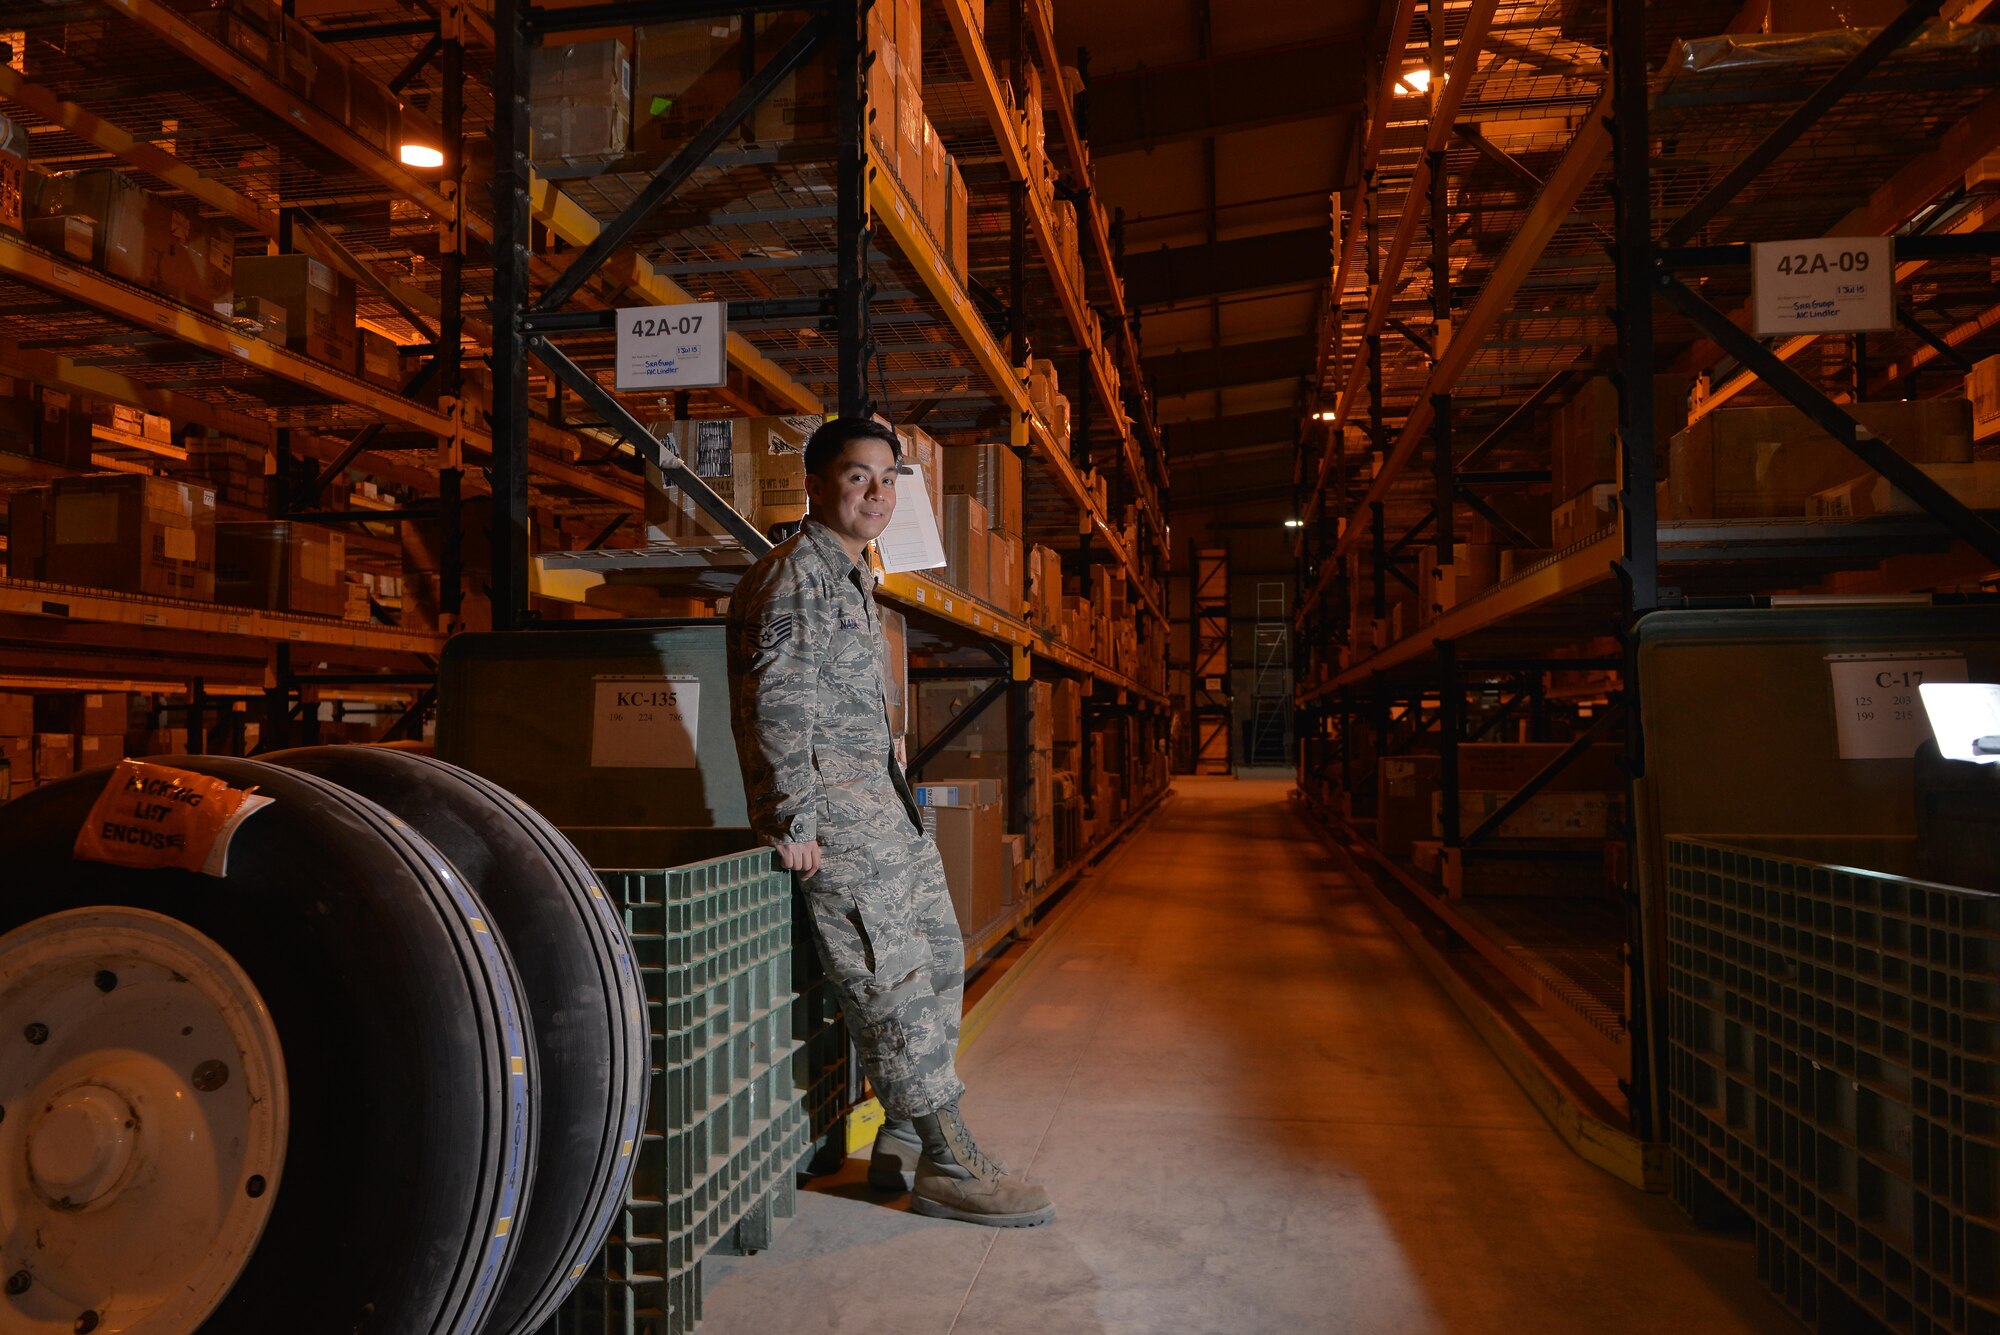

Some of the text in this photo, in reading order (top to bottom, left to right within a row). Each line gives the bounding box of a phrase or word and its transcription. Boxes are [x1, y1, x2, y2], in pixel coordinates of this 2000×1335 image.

[1777, 251, 1870, 275] 42A-09
[632, 316, 703, 338] 42A-07
[1876, 671, 1924, 688] C-17
[617, 692, 677, 706] KC-135
[1855, 696, 1911, 706] 125 203
[609, 713, 683, 722] 196 224 786
[1856, 712, 1875, 721] 199
[509, 1103, 522, 1190] 2014
[459, 1264, 494, 1335] 201
